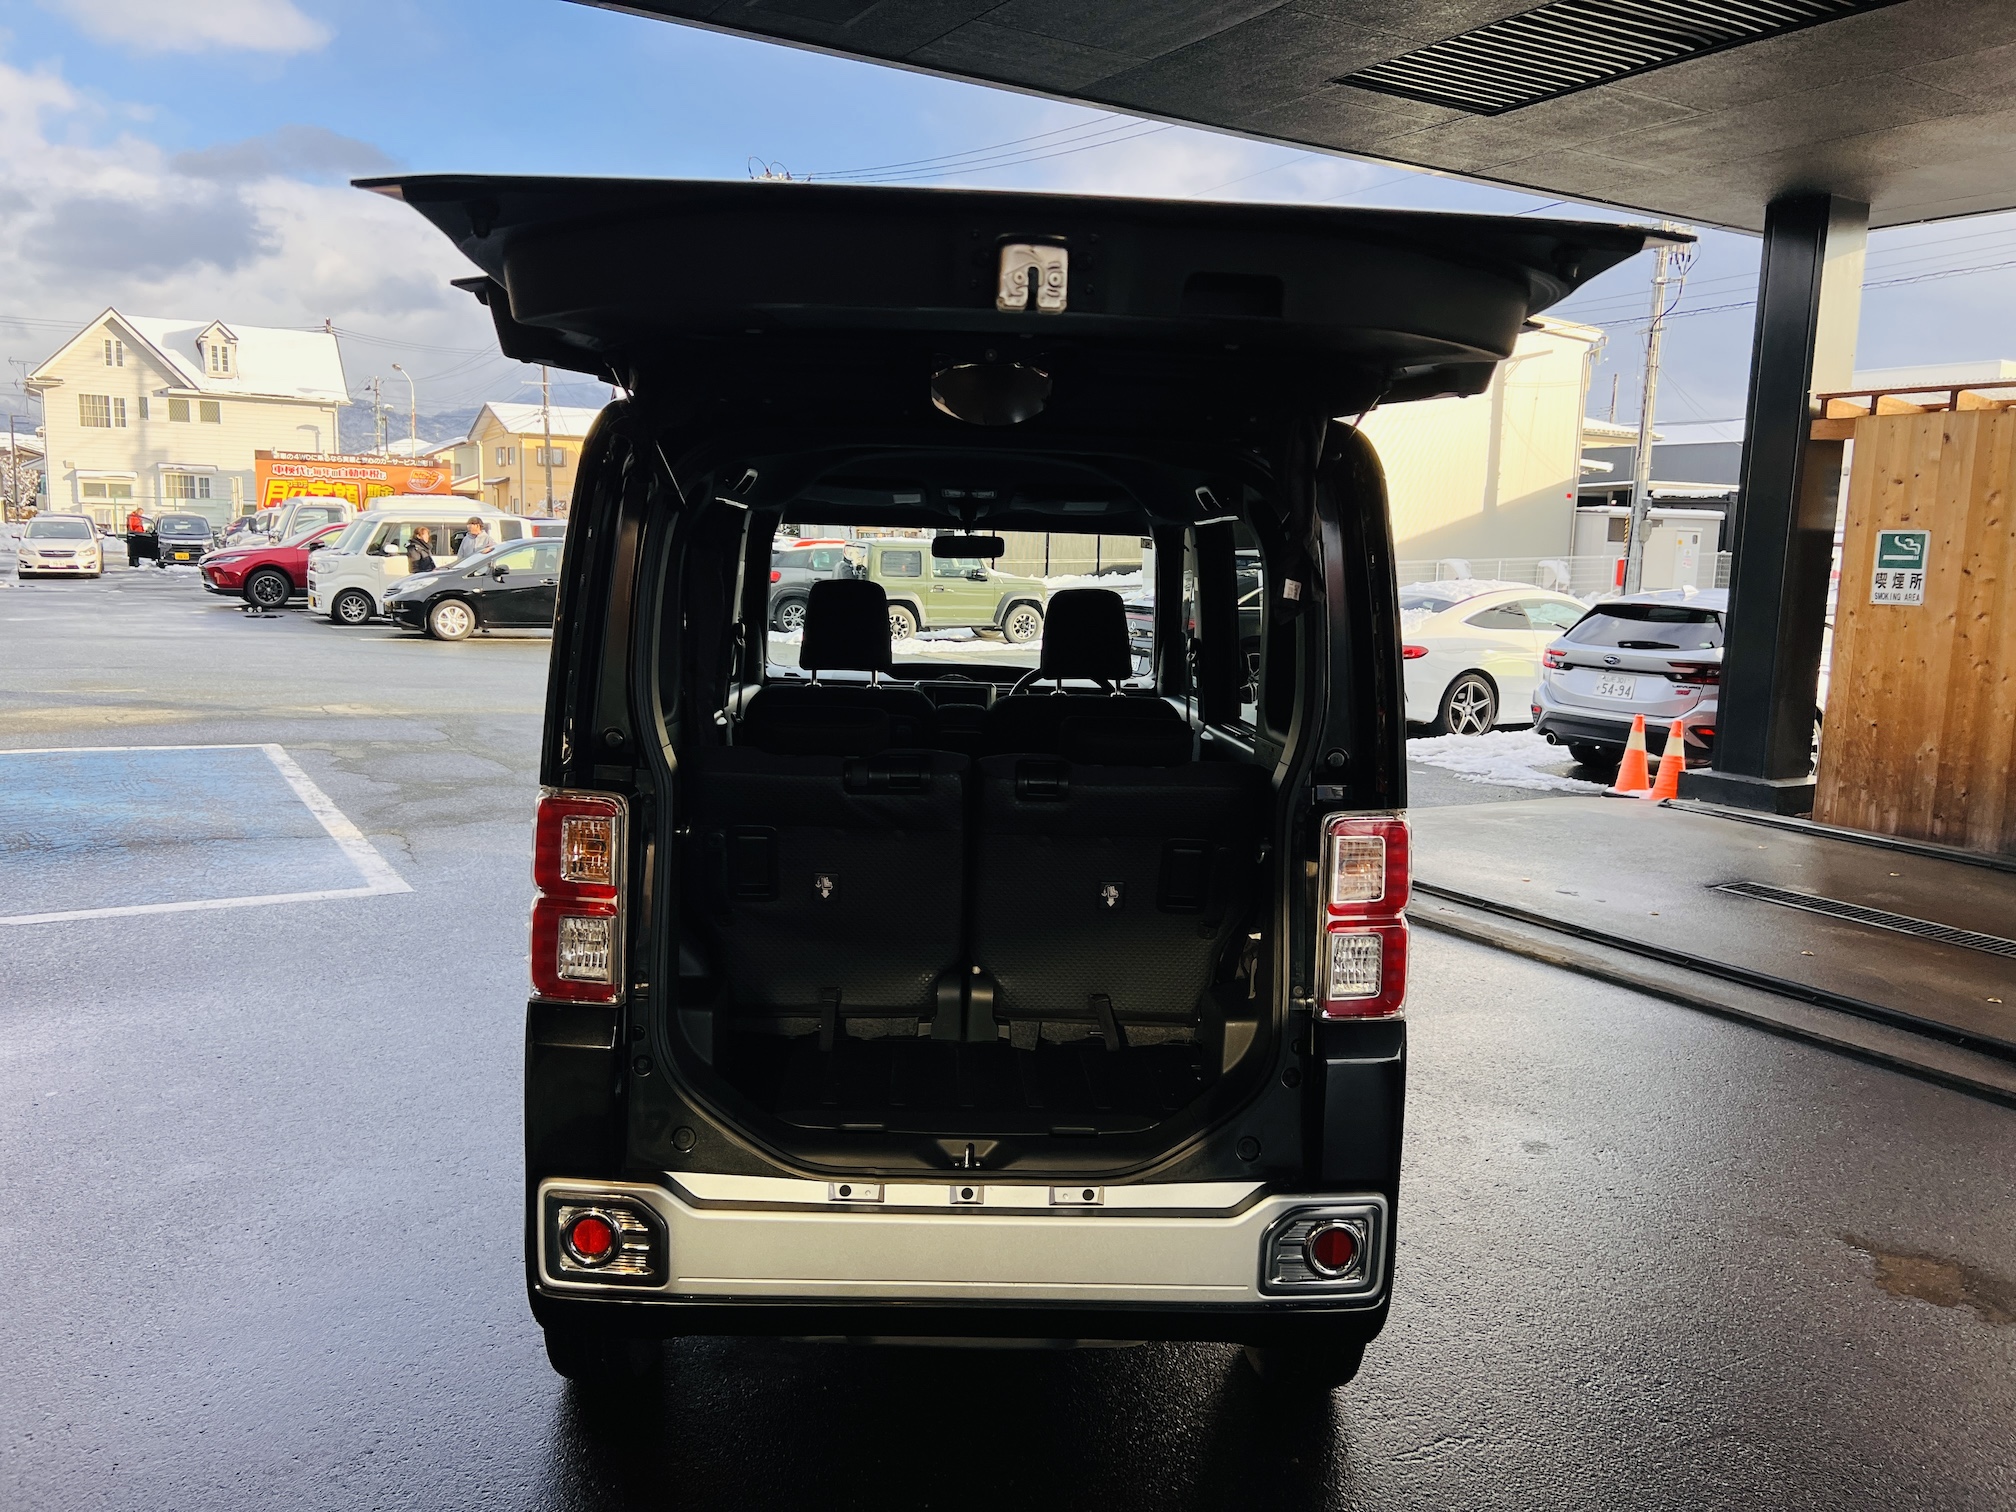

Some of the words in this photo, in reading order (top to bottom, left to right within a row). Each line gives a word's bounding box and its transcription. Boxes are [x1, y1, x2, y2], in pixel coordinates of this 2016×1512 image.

[1874, 572, 1923, 591] 喫煙所
[1874, 592, 1902, 601] SMOKING
[1904, 593, 1921, 602] AREA
[1601, 683, 1631, 697] 54-94
